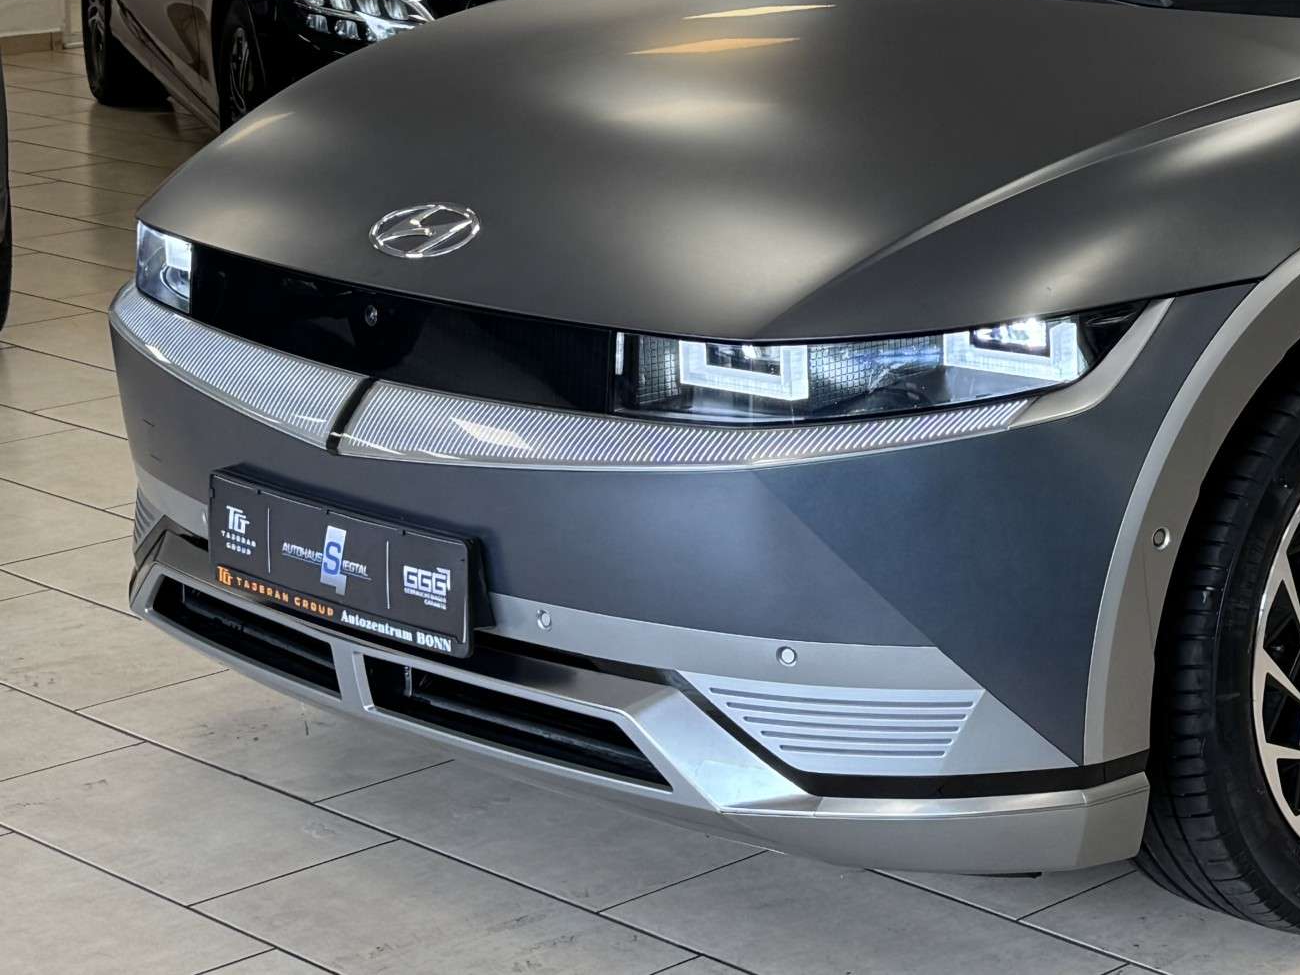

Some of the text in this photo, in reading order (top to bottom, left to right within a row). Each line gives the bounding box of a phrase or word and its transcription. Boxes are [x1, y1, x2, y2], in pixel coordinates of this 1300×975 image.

[226, 542, 252, 555] GROUP
[282, 542, 323, 563] AUTOHAUS
[403, 565, 449, 596] GGG
[235, 577, 289, 602] TAZERAN
[294, 596, 334, 617] GROUP
[340, 610, 413, 642] Autozentrum
[416, 631, 452, 652] BONN
